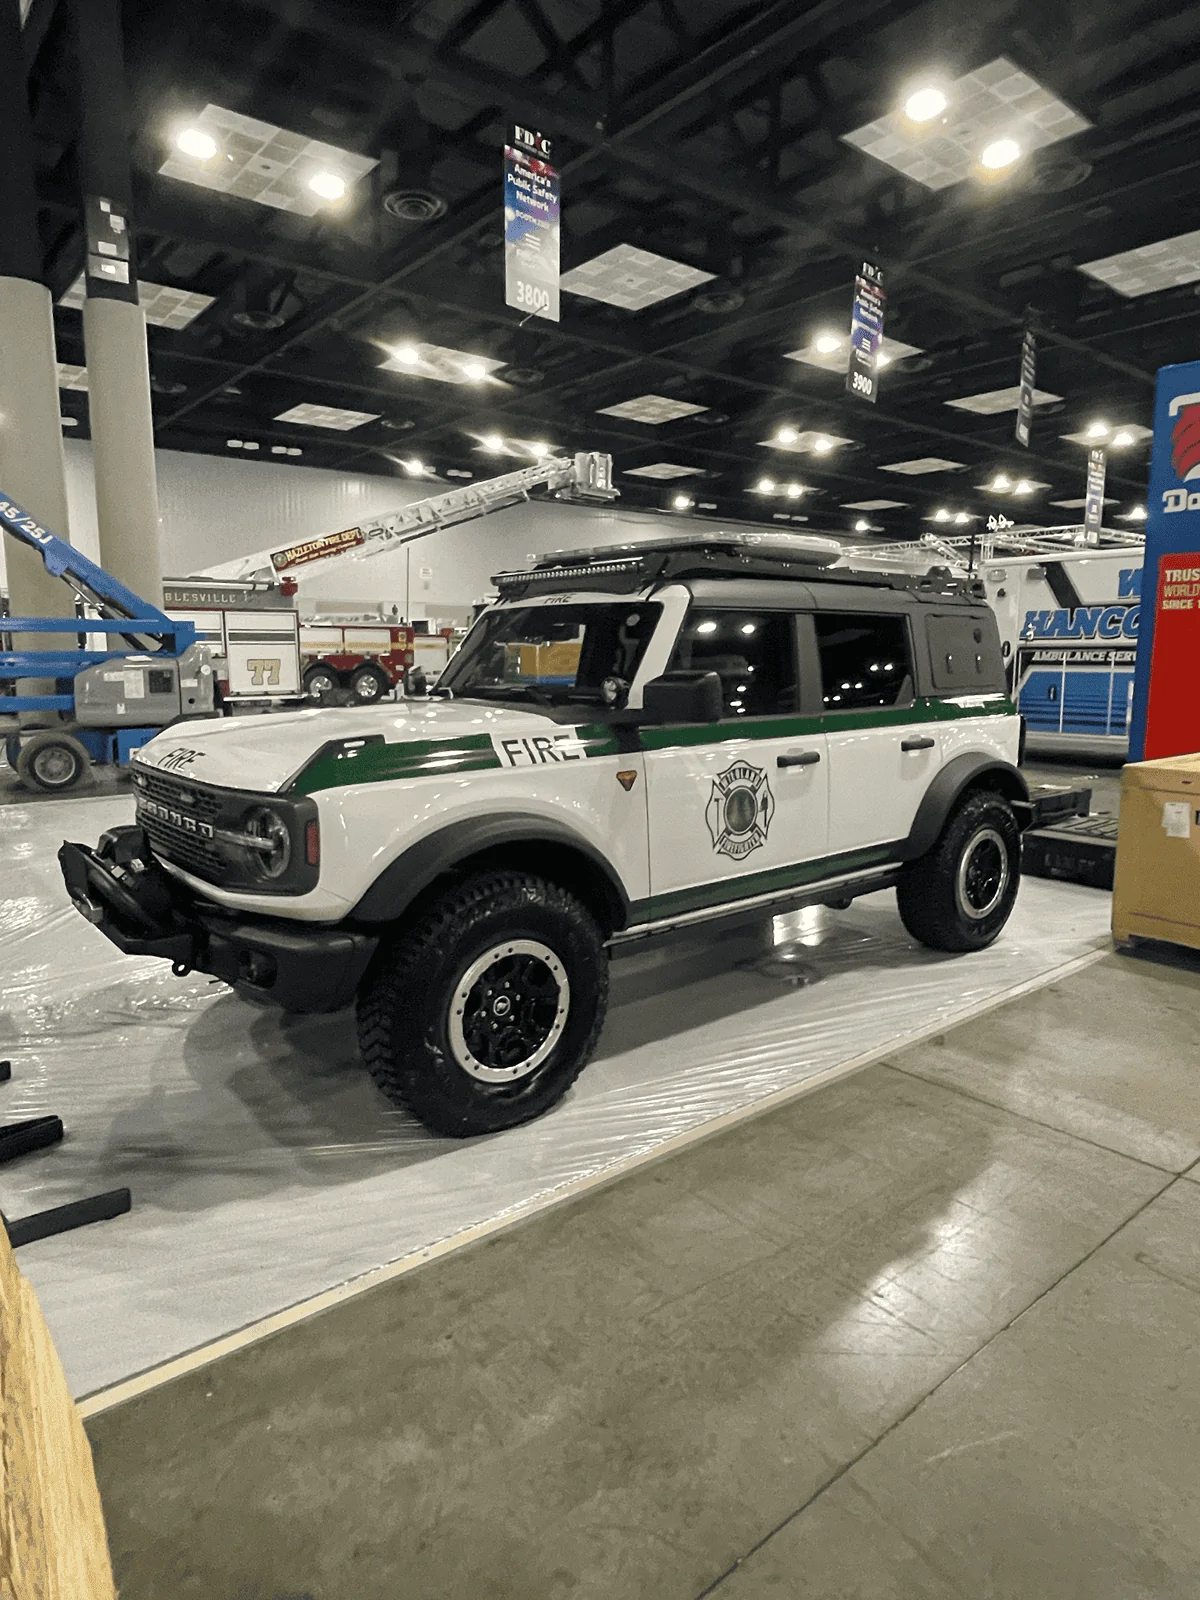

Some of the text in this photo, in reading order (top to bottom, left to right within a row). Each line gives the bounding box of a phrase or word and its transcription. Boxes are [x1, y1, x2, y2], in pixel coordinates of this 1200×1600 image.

[508, 173, 557, 205] Public Safety
[516, 190, 549, 212] Network
[516, 281, 550, 311] 3800
[852, 371, 872, 395] 3900
[1162, 599, 1193, 610] SINCE
[1031, 650, 1106, 661] AMBULANCE
[247, 659, 281, 685] 77
[157, 747, 206, 770] FIRE
[501, 734, 580, 767] FIRE
